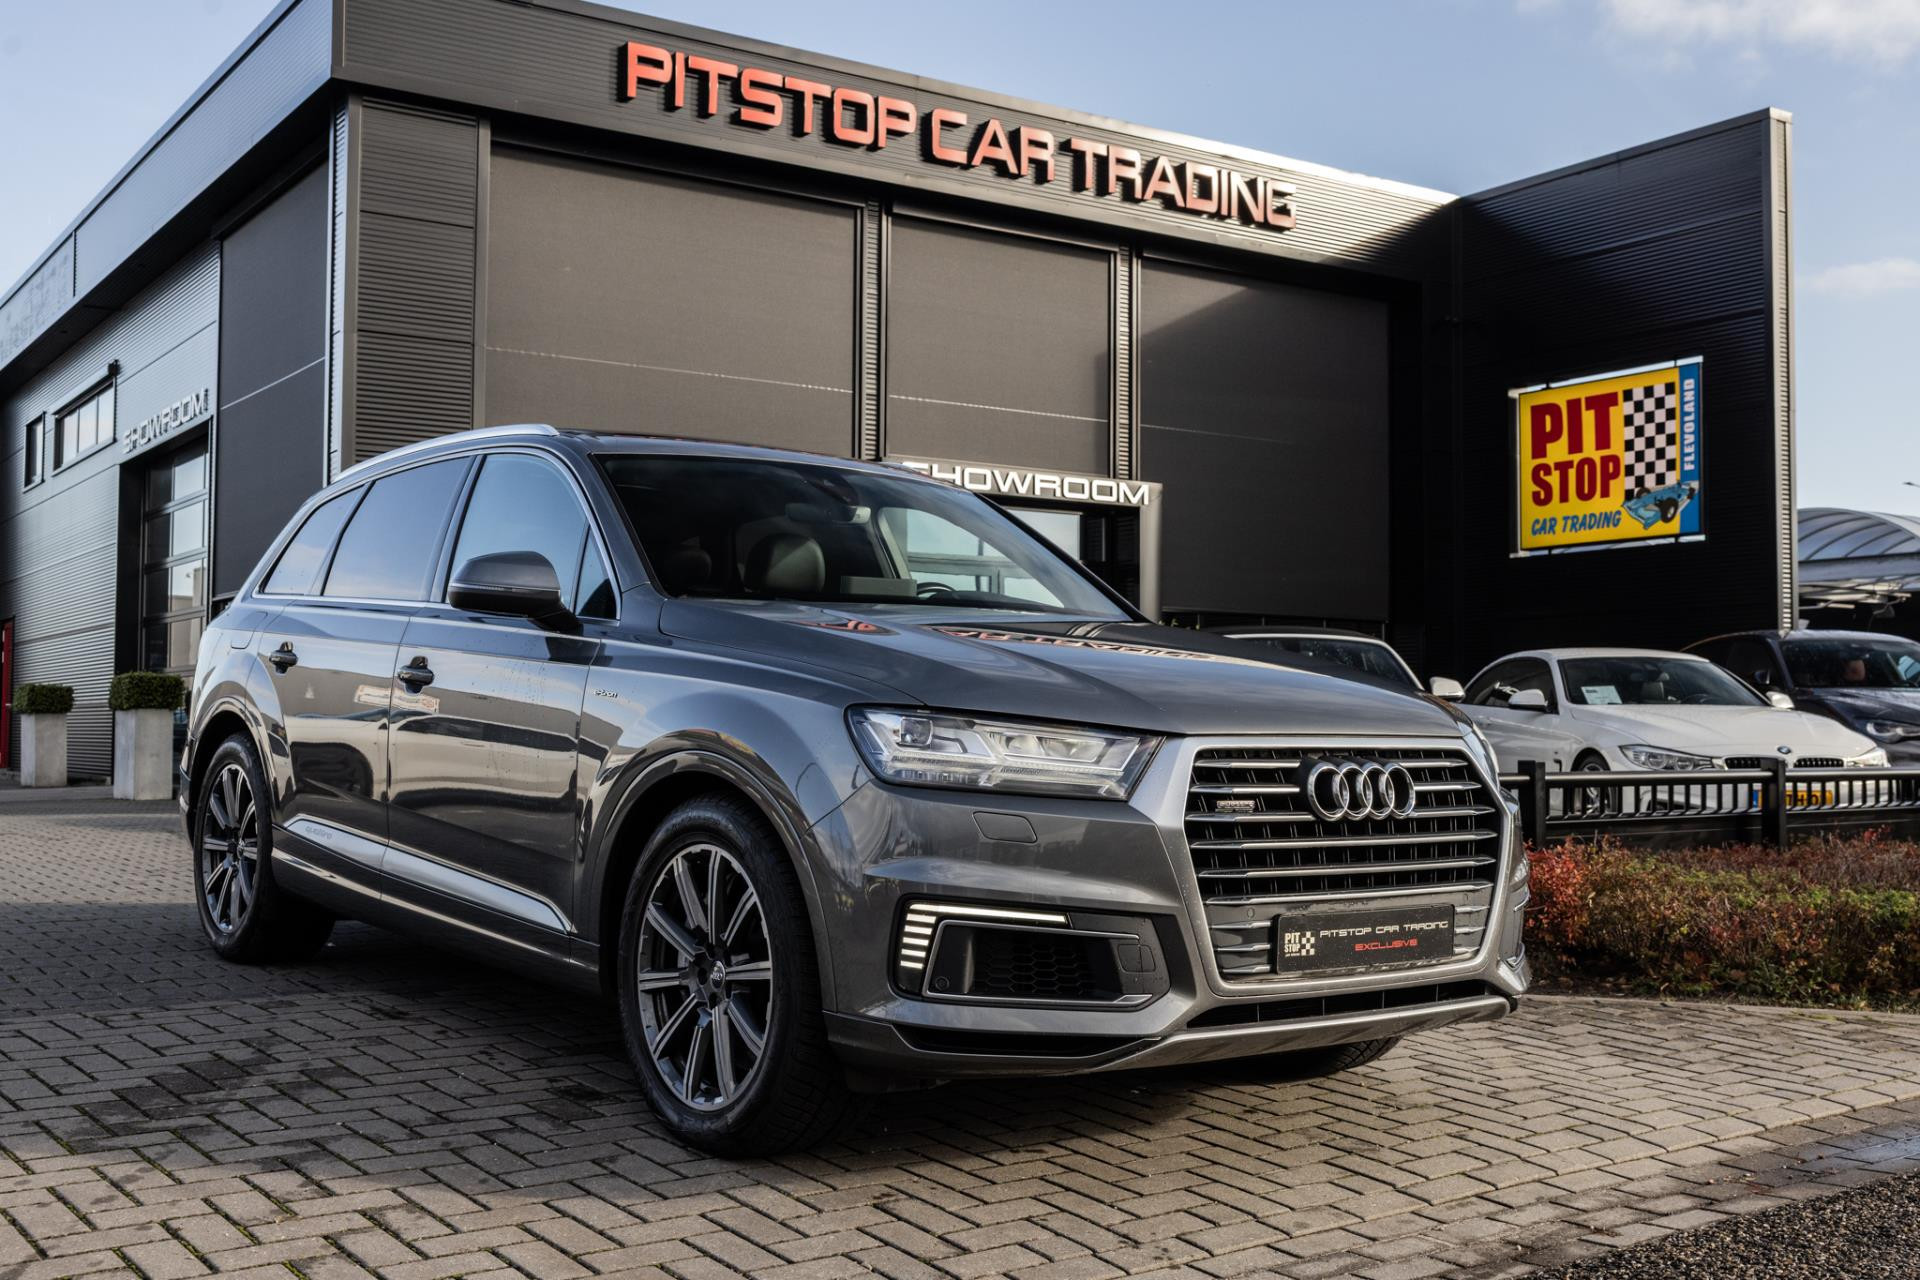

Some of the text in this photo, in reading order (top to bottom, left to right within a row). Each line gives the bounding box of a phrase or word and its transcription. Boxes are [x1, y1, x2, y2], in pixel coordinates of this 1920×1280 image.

[626, 41, 1297, 229] PITSTOP CAR TRADING
[123, 387, 207, 454] SHOWROOM
[1531, 392, 1619, 459] PIT
[1684, 378, 1696, 471] FLEVOLAND
[1532, 455, 1621, 506] STOP
[1531, 510, 1622, 536] CAR TRADING
[1284, 932, 1300, 944] PIT
[1284, 944, 1300, 953] STOP
[1319, 921, 1448, 938] PITSTOP CAR TRADING
[1355, 939, 1418, 951] EXCLUSIVE
